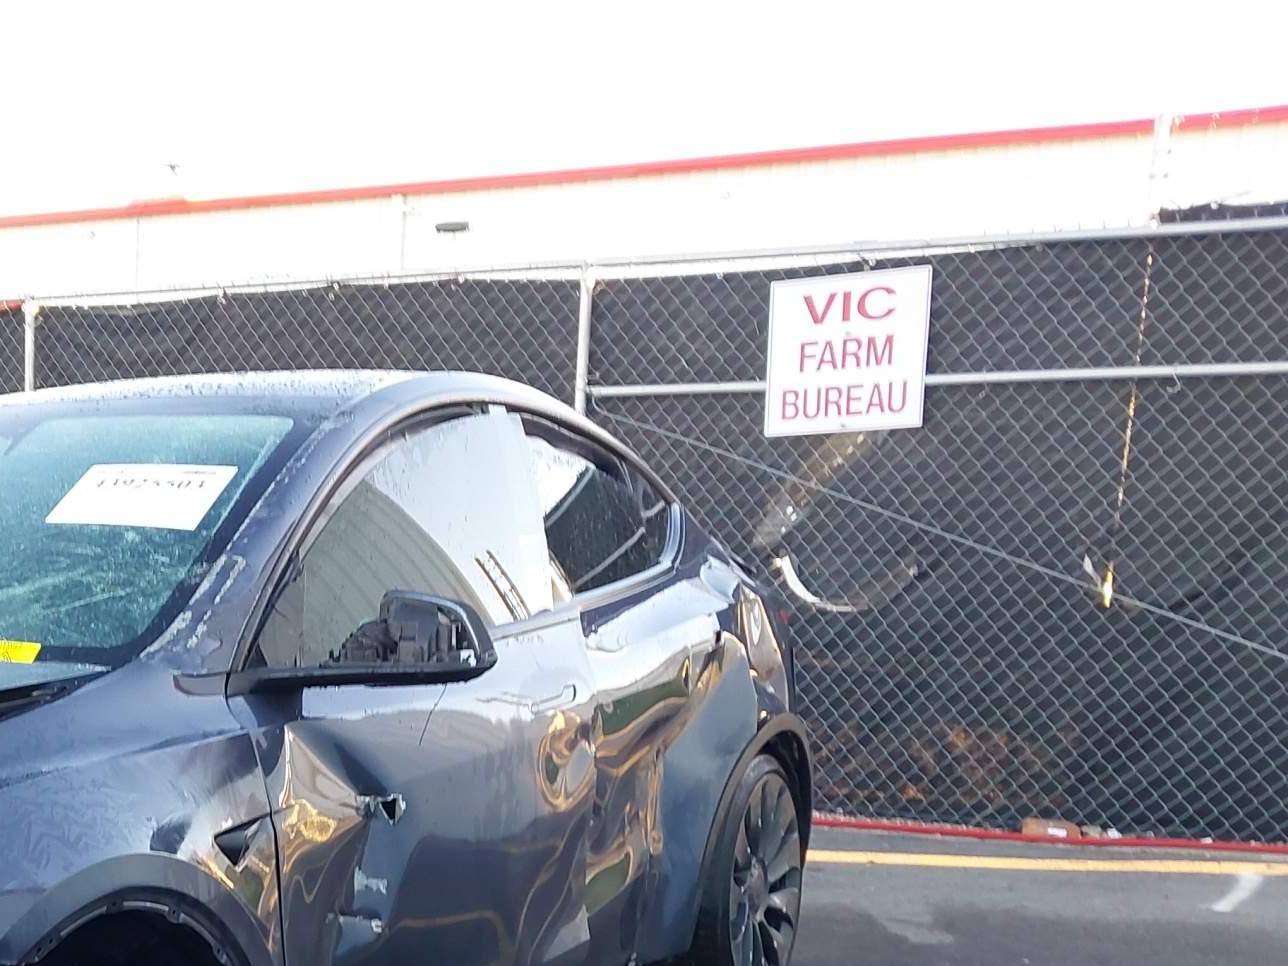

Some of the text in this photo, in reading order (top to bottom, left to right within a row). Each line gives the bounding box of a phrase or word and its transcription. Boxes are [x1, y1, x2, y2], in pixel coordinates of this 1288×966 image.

[803, 286, 896, 324] VIC
[799, 334, 895, 372] FARM
[781, 380, 908, 421] BUREAU
